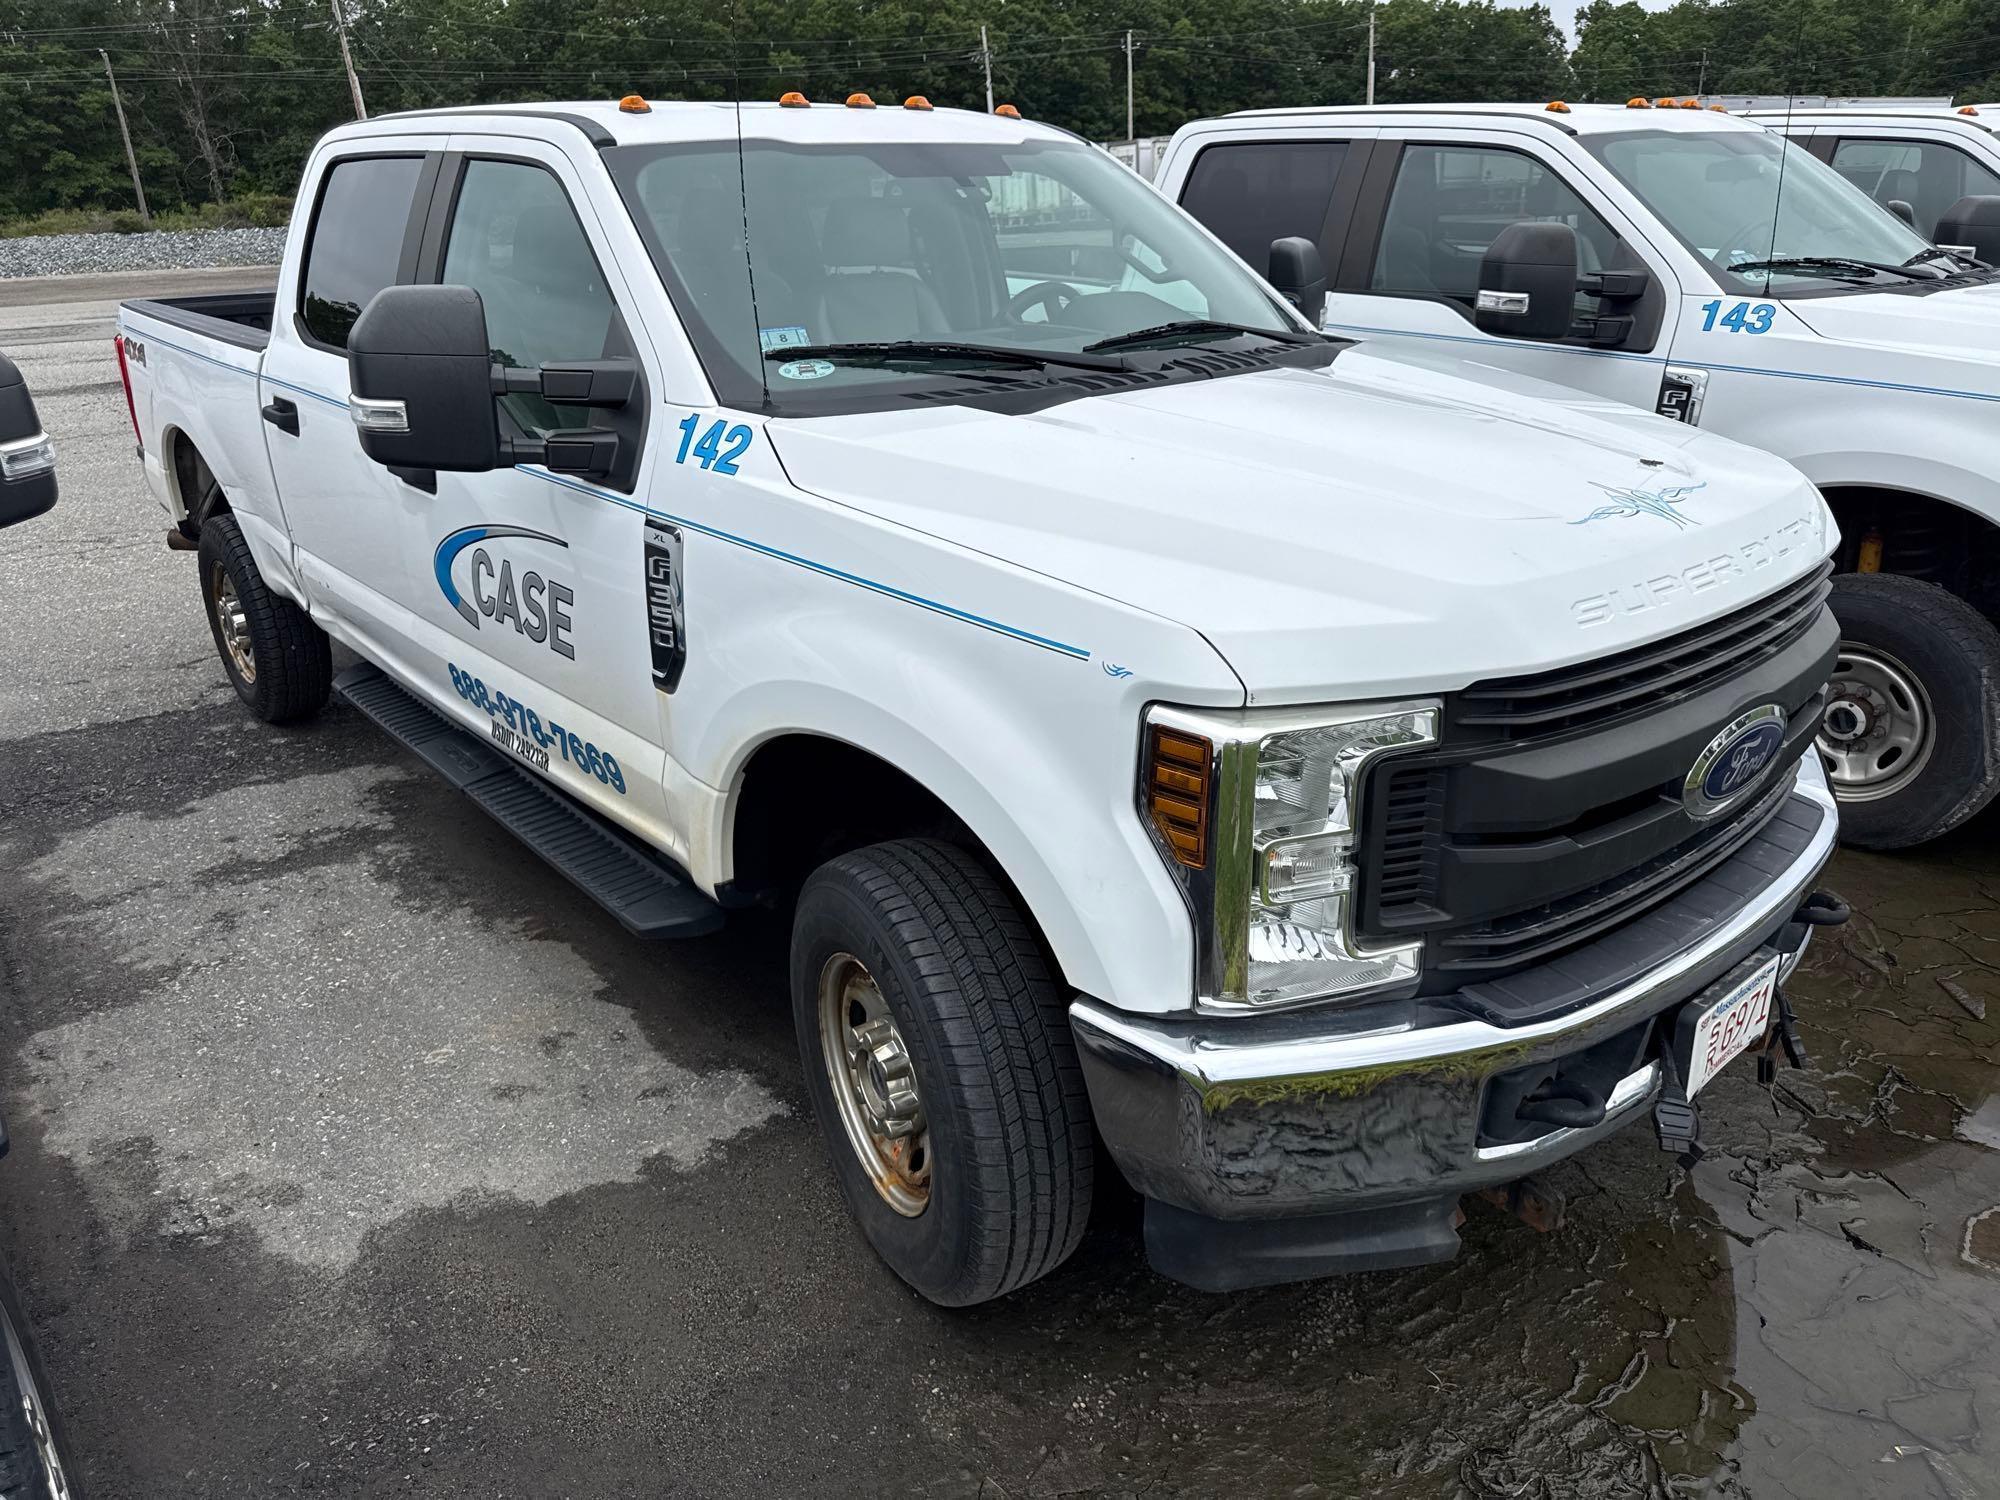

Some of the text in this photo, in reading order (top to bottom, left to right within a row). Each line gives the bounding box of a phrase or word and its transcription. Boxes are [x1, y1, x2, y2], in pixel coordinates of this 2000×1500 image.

[779, 334, 788, 343] 8
[1701, 299, 1777, 335] 143
[675, 413, 754, 476] 142
[653, 533, 666, 544] XL
[1569, 511, 1819, 630] SUPER DUTY
[471, 547, 576, 662] CASE
[448, 662, 627, 795] 888-978-7669
[491, 719, 515, 751] USDOT
[1721, 736, 1773, 792] Ford
